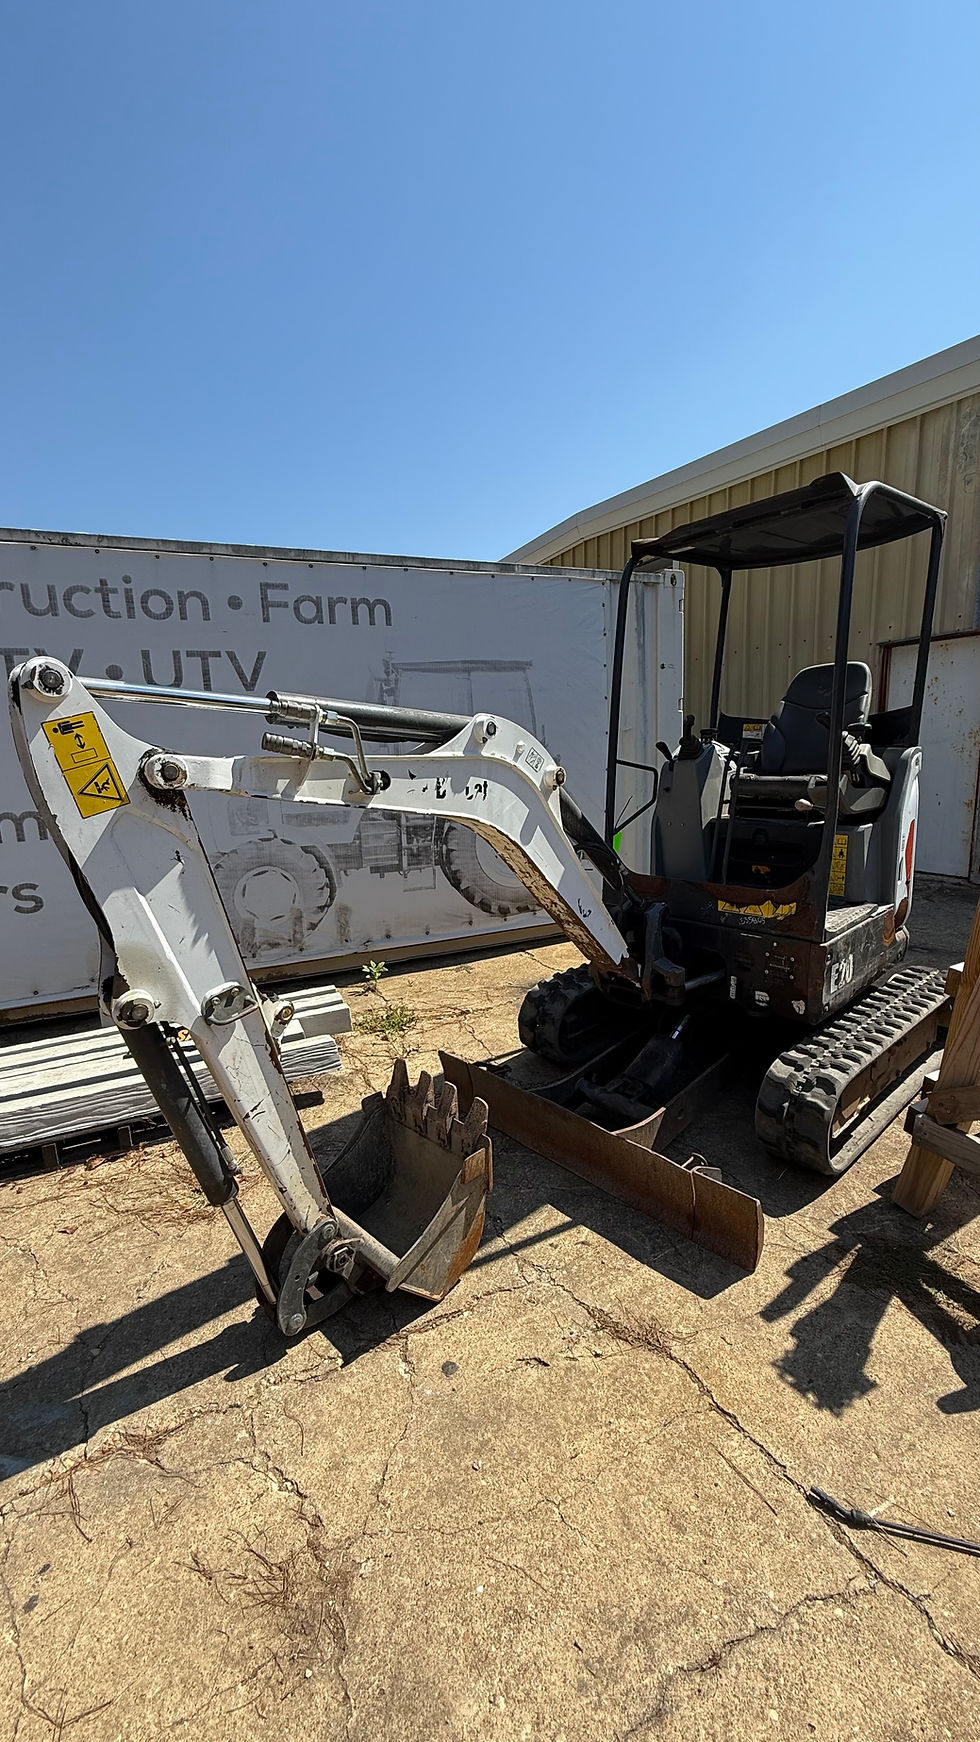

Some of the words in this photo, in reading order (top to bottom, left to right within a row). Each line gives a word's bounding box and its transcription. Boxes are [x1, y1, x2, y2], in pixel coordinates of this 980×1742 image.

[259, 582, 392, 626] Farm
[141, 650, 267, 692] UTV
[830, 953, 854, 994] E20
